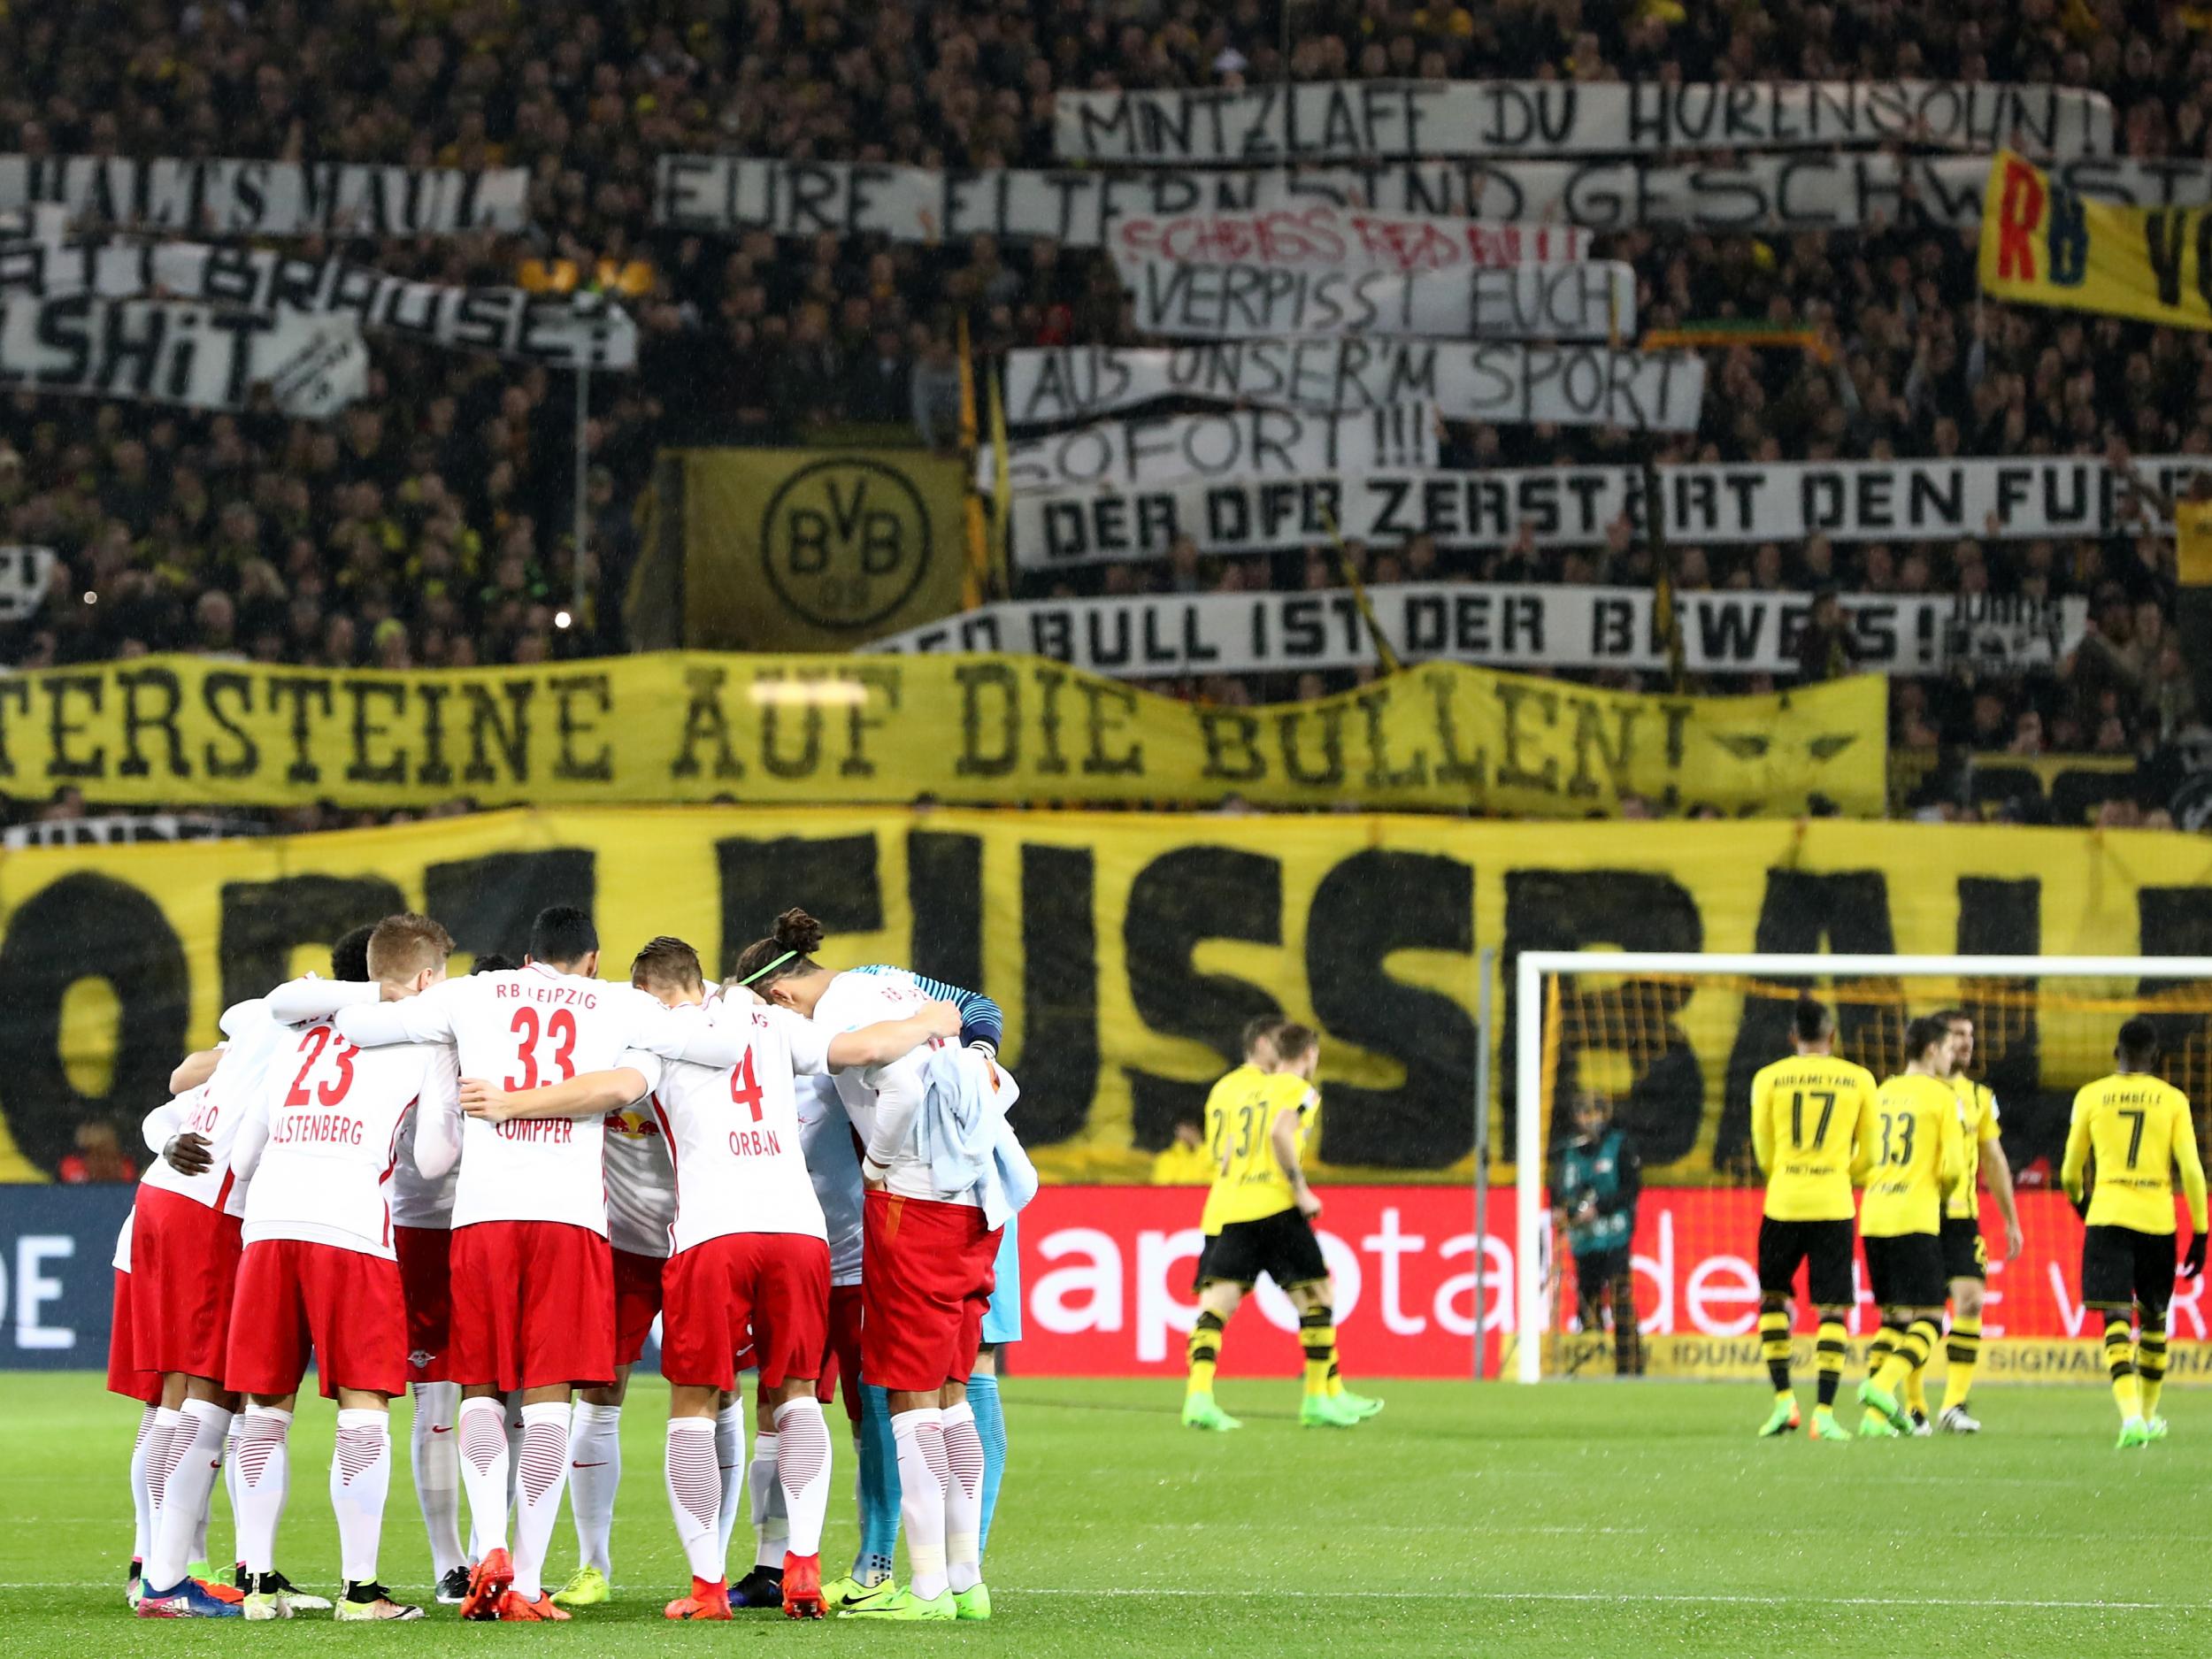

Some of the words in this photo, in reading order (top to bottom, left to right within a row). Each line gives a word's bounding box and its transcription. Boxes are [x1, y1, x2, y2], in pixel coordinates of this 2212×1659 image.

[1481, 83, 1578, 147] DU
[1148, 264, 1426, 334] VERPISST
[1470, 267, 1616, 337] EUCH
[1025, 349, 1133, 418] AUS
[1469, 349, 1690, 432] SPORT
[790, 476, 902, 573] BVB
[1042, 493, 1179, 556] DER
[1801, 469, 1964, 529] DEN
[1030, 605, 1219, 665] BULL
[1253, 595, 1373, 658] IST
[1406, 595, 1545, 655] DER
[670, 658, 901, 780] AUF
[956, 664, 1143, 779] DIE
[496, 983, 520, 998] RB
[283, 1025, 361, 1108] 23
[503, 1006, 577, 1094] 33
[730, 1043, 764, 1123] 4
[1792, 1090, 1836, 1150] 17
[2118, 1110, 2145, 1170] 7
[0, 1235, 75, 1348] E
